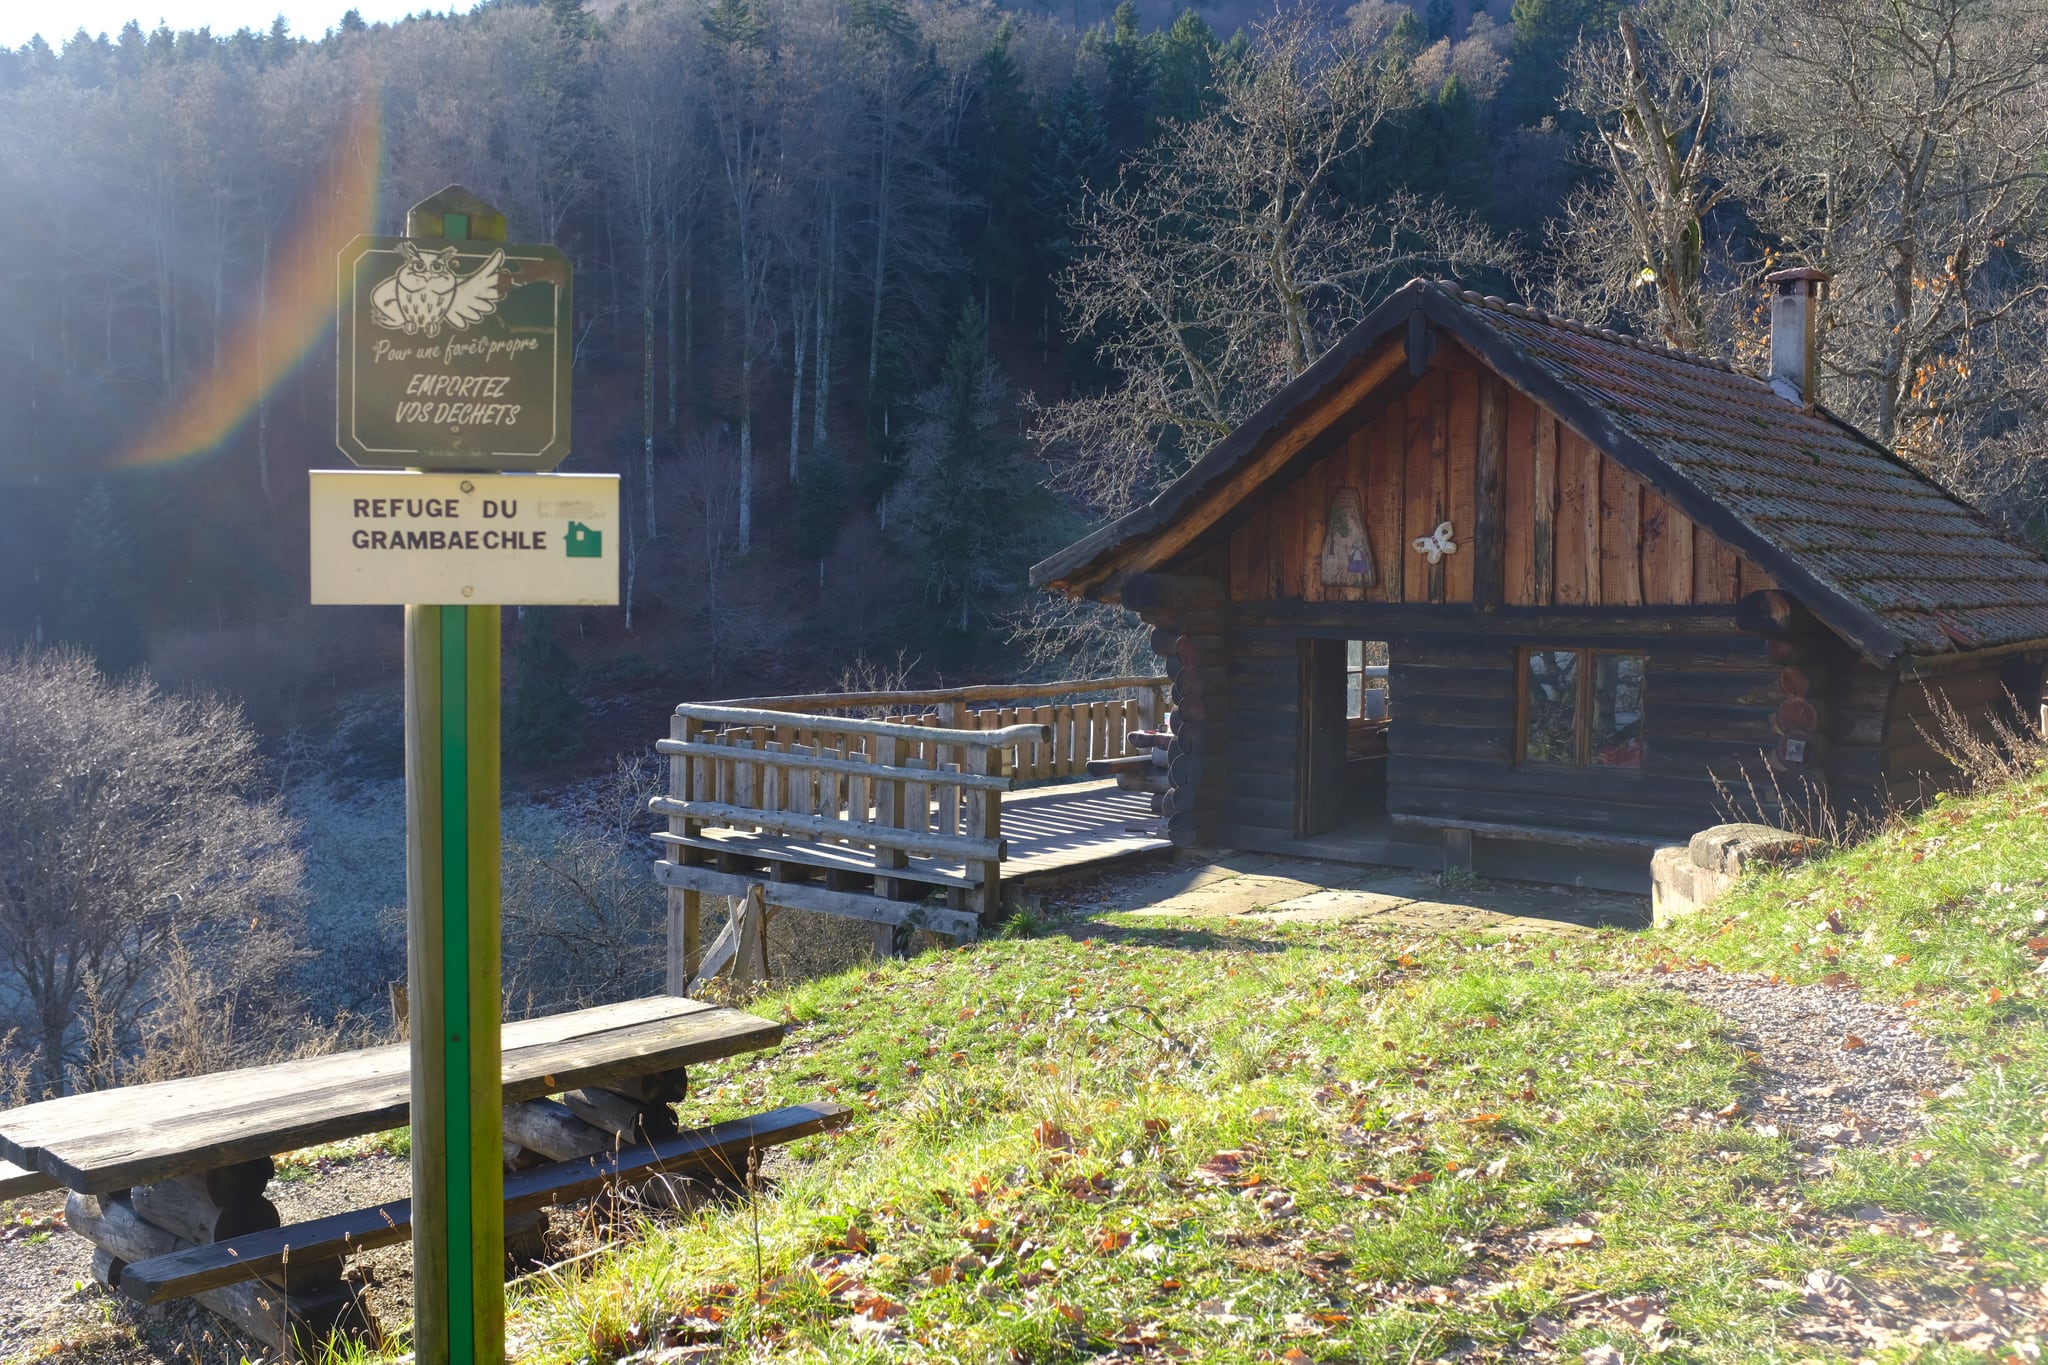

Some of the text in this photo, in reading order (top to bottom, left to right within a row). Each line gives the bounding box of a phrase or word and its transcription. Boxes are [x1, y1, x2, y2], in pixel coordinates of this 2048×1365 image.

[374, 339, 412, 364] Pour
[416, 345, 441, 360] une
[485, 337, 539, 363] propre
[406, 373, 511, 398] EMPORTEZ
[395, 401, 521, 426] VOS DECHETS
[353, 498, 518, 519] REFUGE DU
[351, 529, 548, 551] GRAMBAECHLE
